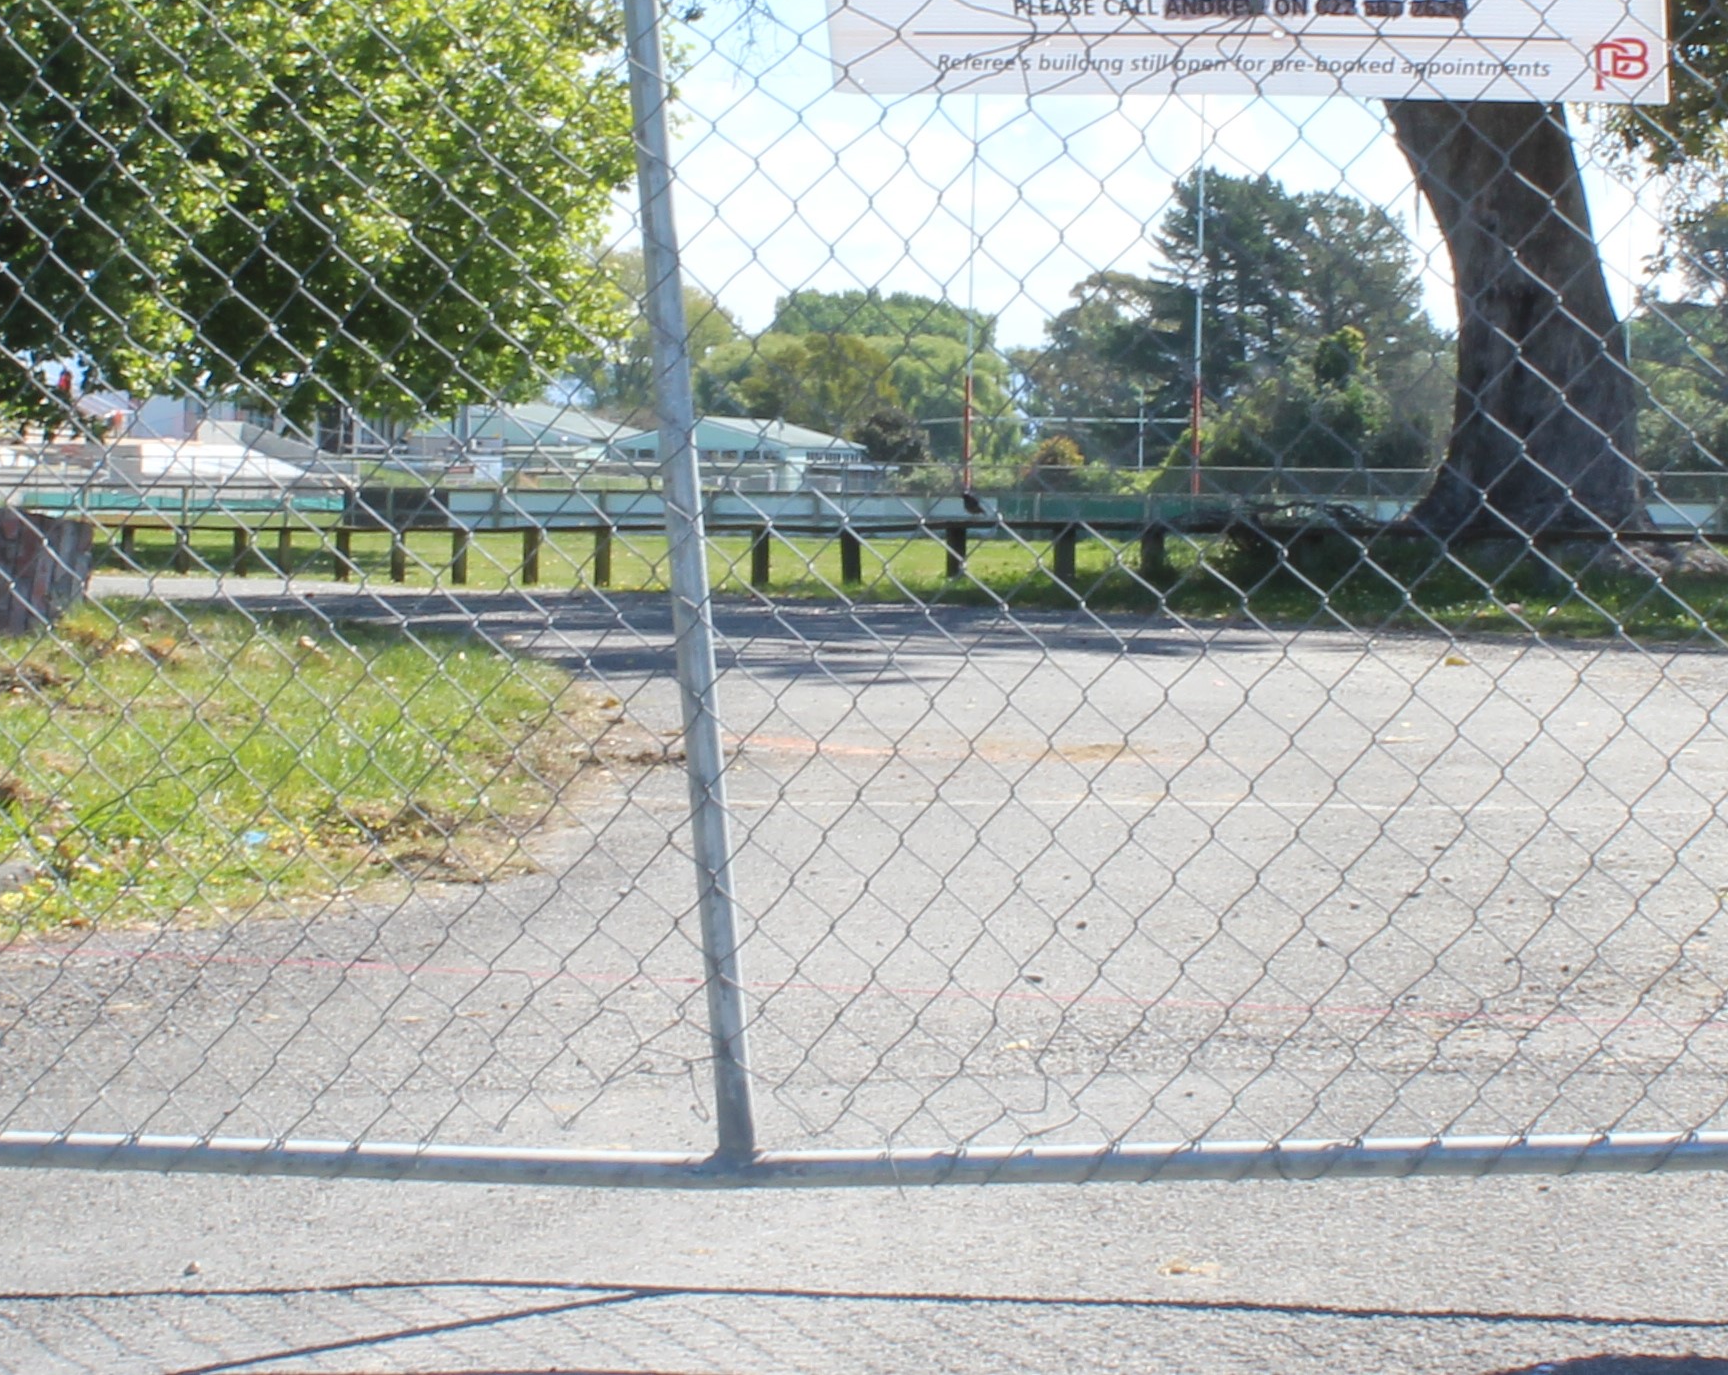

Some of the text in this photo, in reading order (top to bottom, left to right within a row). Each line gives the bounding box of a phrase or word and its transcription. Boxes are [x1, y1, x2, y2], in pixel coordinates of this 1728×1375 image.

[937, 53, 1551, 82] Referee's building still open for pre-booked appointments
